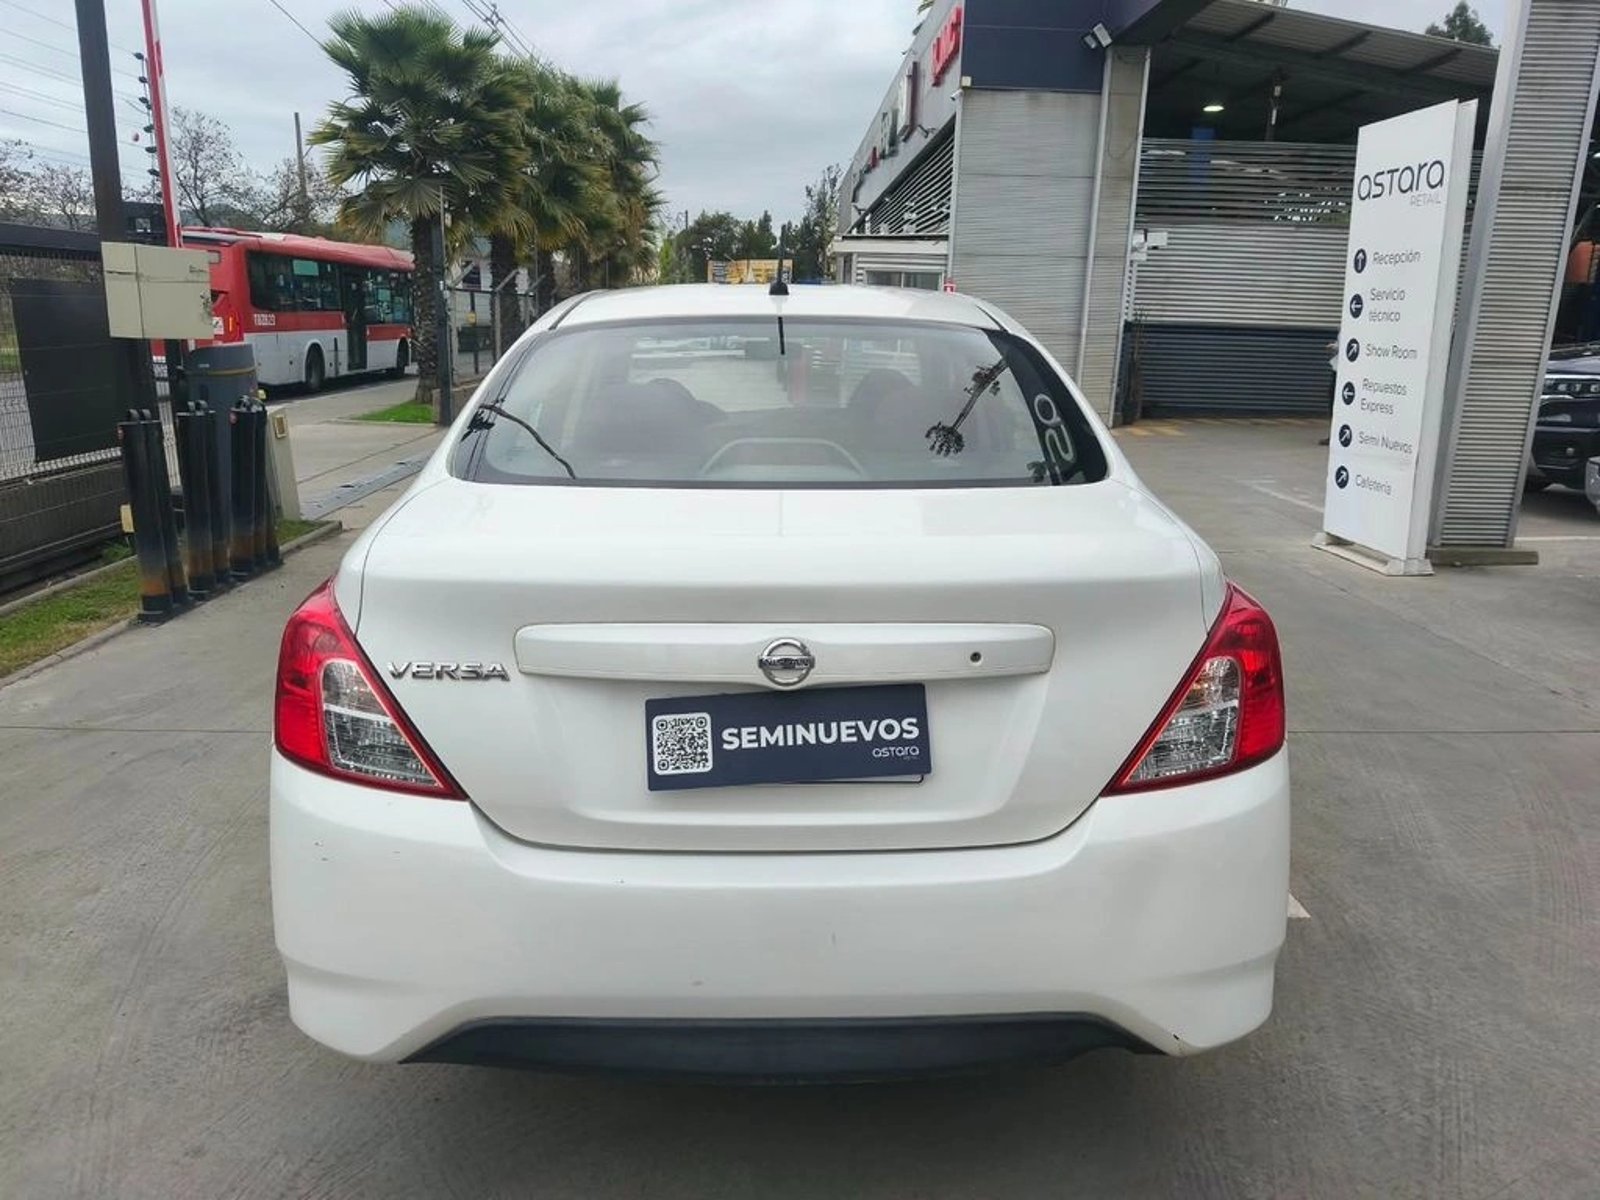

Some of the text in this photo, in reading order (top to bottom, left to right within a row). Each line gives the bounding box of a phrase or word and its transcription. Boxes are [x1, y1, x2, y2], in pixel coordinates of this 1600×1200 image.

[1357, 160, 1445, 201] astara
[1372, 250, 1421, 266] Recepción
[1369, 287, 1406, 301] Servicio
[1365, 343, 1418, 360] Show Room
[1361, 378, 1407, 397] Repuestos
[1360, 397, 1394, 415] Express
[1358, 431, 1413, 454] Semi Nuevos
[387, 661, 511, 682] VERSA
[721, 717, 920, 750] SEMINUEVOS
[872, 745, 920, 758] astara
